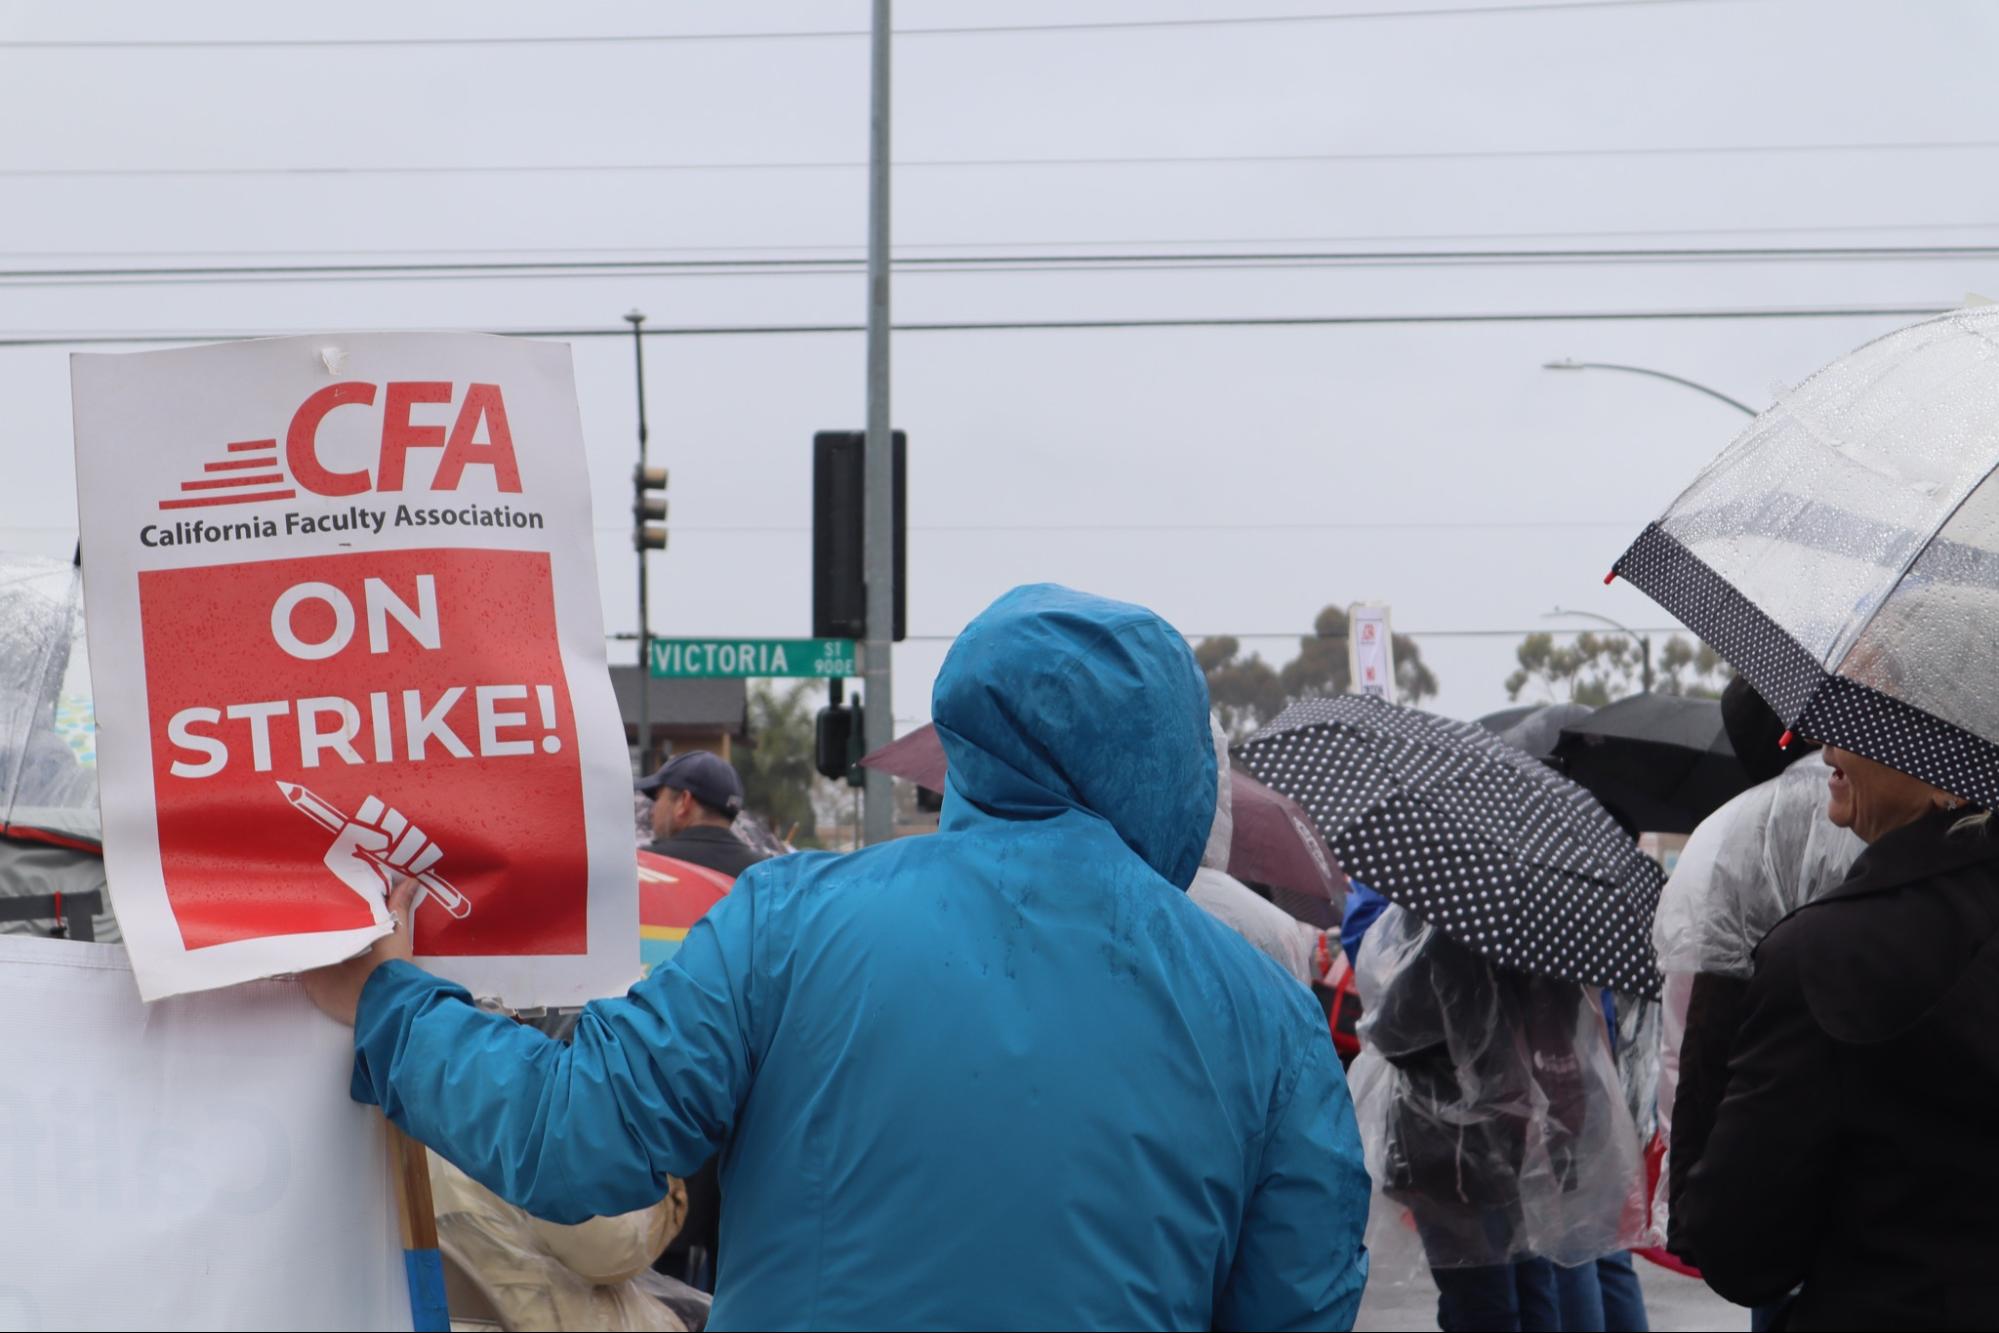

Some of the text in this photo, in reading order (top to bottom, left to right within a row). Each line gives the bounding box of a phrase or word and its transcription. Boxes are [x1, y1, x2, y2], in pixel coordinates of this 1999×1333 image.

[286, 381, 523, 497] CFA
[140, 504, 544, 547] California Faculty Association
[271, 574, 441, 660] ON
[824, 642, 842, 656] ST
[655, 644, 788, 672] VICTORIA
[167, 685, 561, 778] STRIKE!
